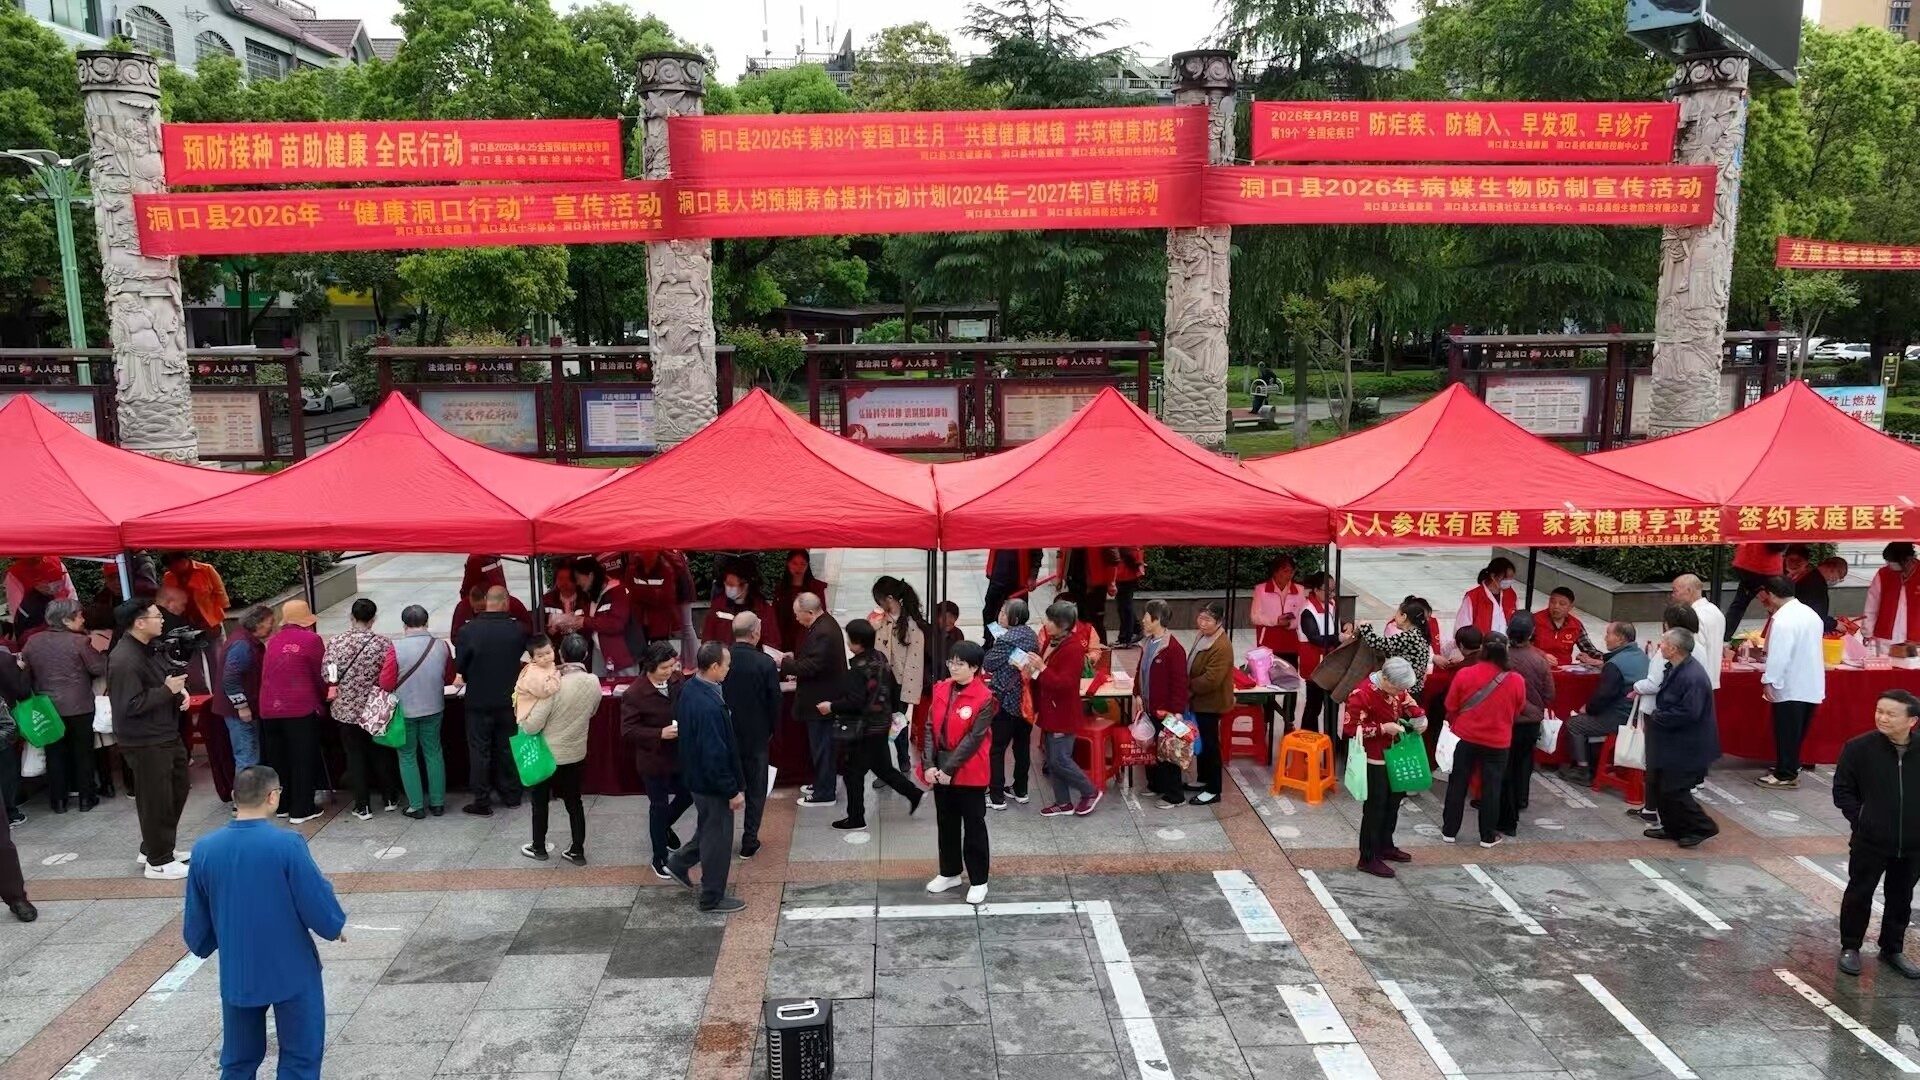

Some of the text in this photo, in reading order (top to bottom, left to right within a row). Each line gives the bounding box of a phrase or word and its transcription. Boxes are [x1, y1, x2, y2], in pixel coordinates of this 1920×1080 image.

[1271, 110, 1359, 123] 2026年4月26日
[1369, 112, 1653, 138] 防疟疾、防输入、早发现、早诊疗
[701, 123, 945, 152] 洞口县2026年第38个爱国卫生月
[183, 129, 463, 171] 预防接种 苗助健康 全民行动
[1239, 176, 1702, 199] 洞口县2026年病媒生物防制宣传活动
[146, 202, 323, 232] 洞口县2026年
[553, 191, 662, 222] 宣传活动
[1496, 349, 1575, 359] 法治洞口 人人共建
[427, 361, 514, 372] 法治洞口 人人共建
[599, 361, 633, 370] 法治洞口
[855, 359, 938, 369] 法治洞口 人人共享
[1021, 356, 1103, 367] 法治洞口 人人共享
[34, 364, 71, 374] 人人共建
[213, 364, 249, 373] 人人共享
[1339, 508, 1721, 537] 人人参保有医靠 家家健康享平安
[1738, 505, 1906, 531] 签约家庭医生
